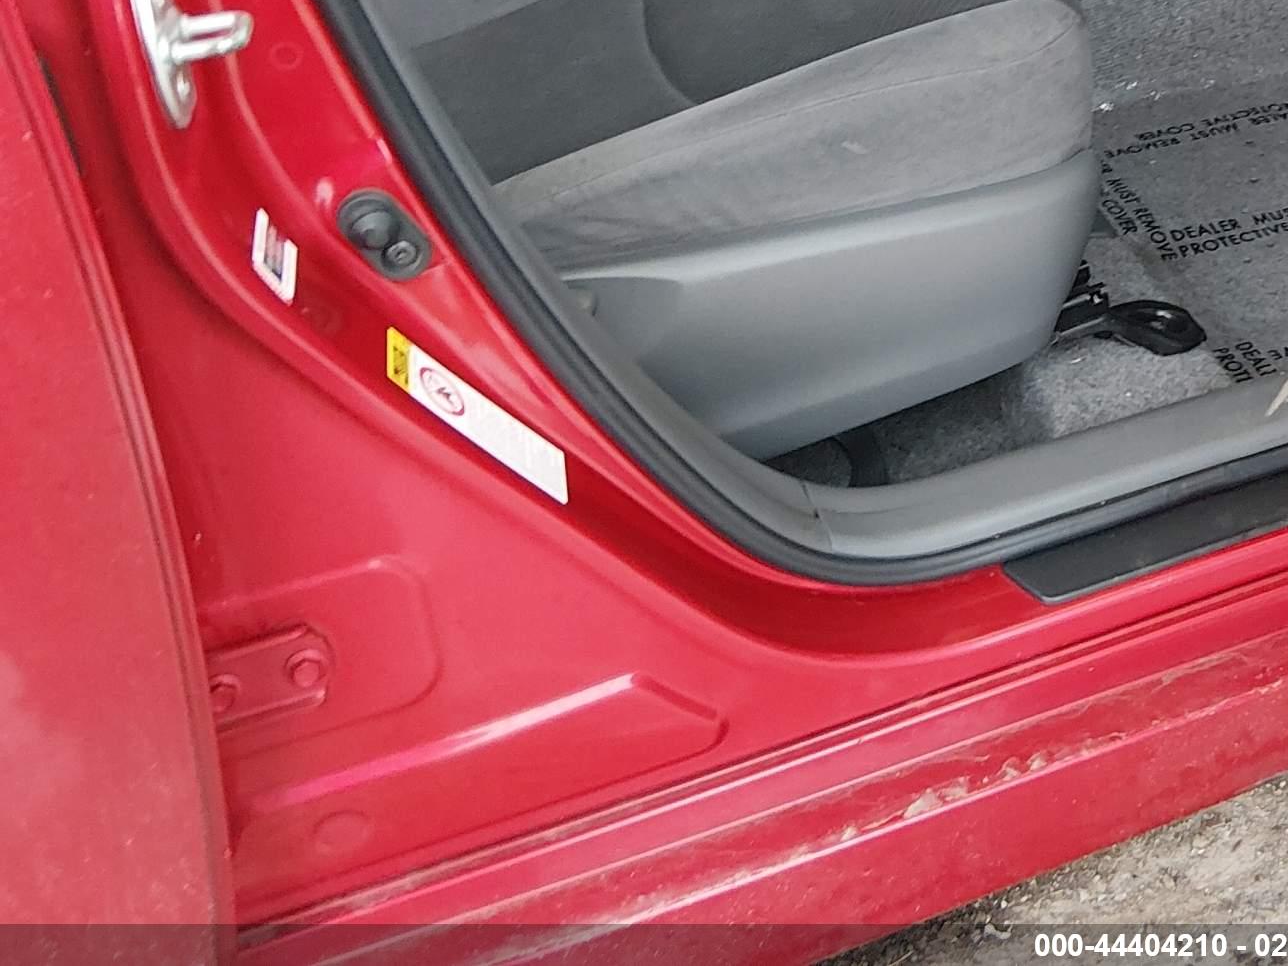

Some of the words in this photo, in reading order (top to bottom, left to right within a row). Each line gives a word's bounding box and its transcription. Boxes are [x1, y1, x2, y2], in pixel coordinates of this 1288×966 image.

[1101, 199, 1138, 235] COVER
[1132, 207, 1178, 261] REMOVE
[1170, 218, 1242, 243] DEALER
